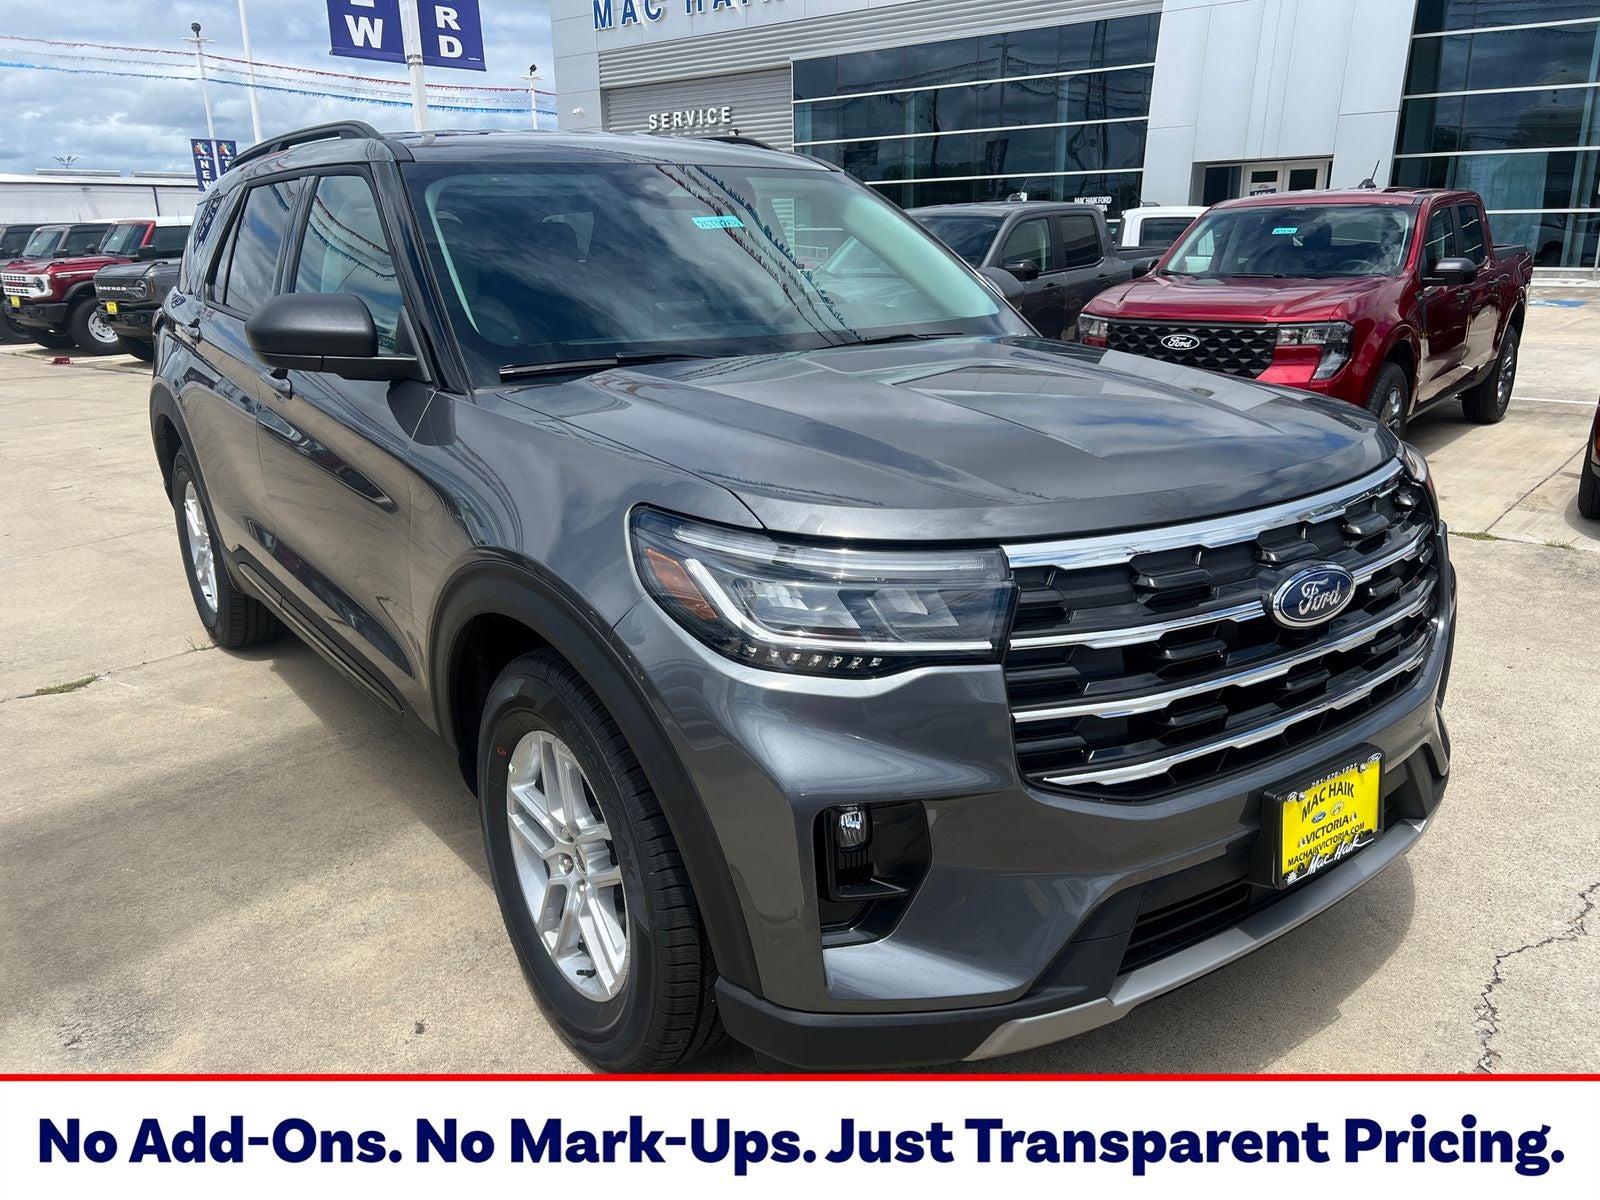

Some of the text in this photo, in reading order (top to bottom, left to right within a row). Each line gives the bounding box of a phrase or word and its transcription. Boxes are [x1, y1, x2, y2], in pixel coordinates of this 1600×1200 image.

[592, 0, 662, 30] MAC
[648, 106, 731, 129] SERVICE
[200, 160, 215, 190] NEW
[1298, 577, 1341, 616] Ford
[1302, 787, 1327, 823] MAC
[1328, 781, 1355, 799] HAIK
[1305, 815, 1349, 845] VICTORIA
[1307, 853, 1334, 875] Mac
